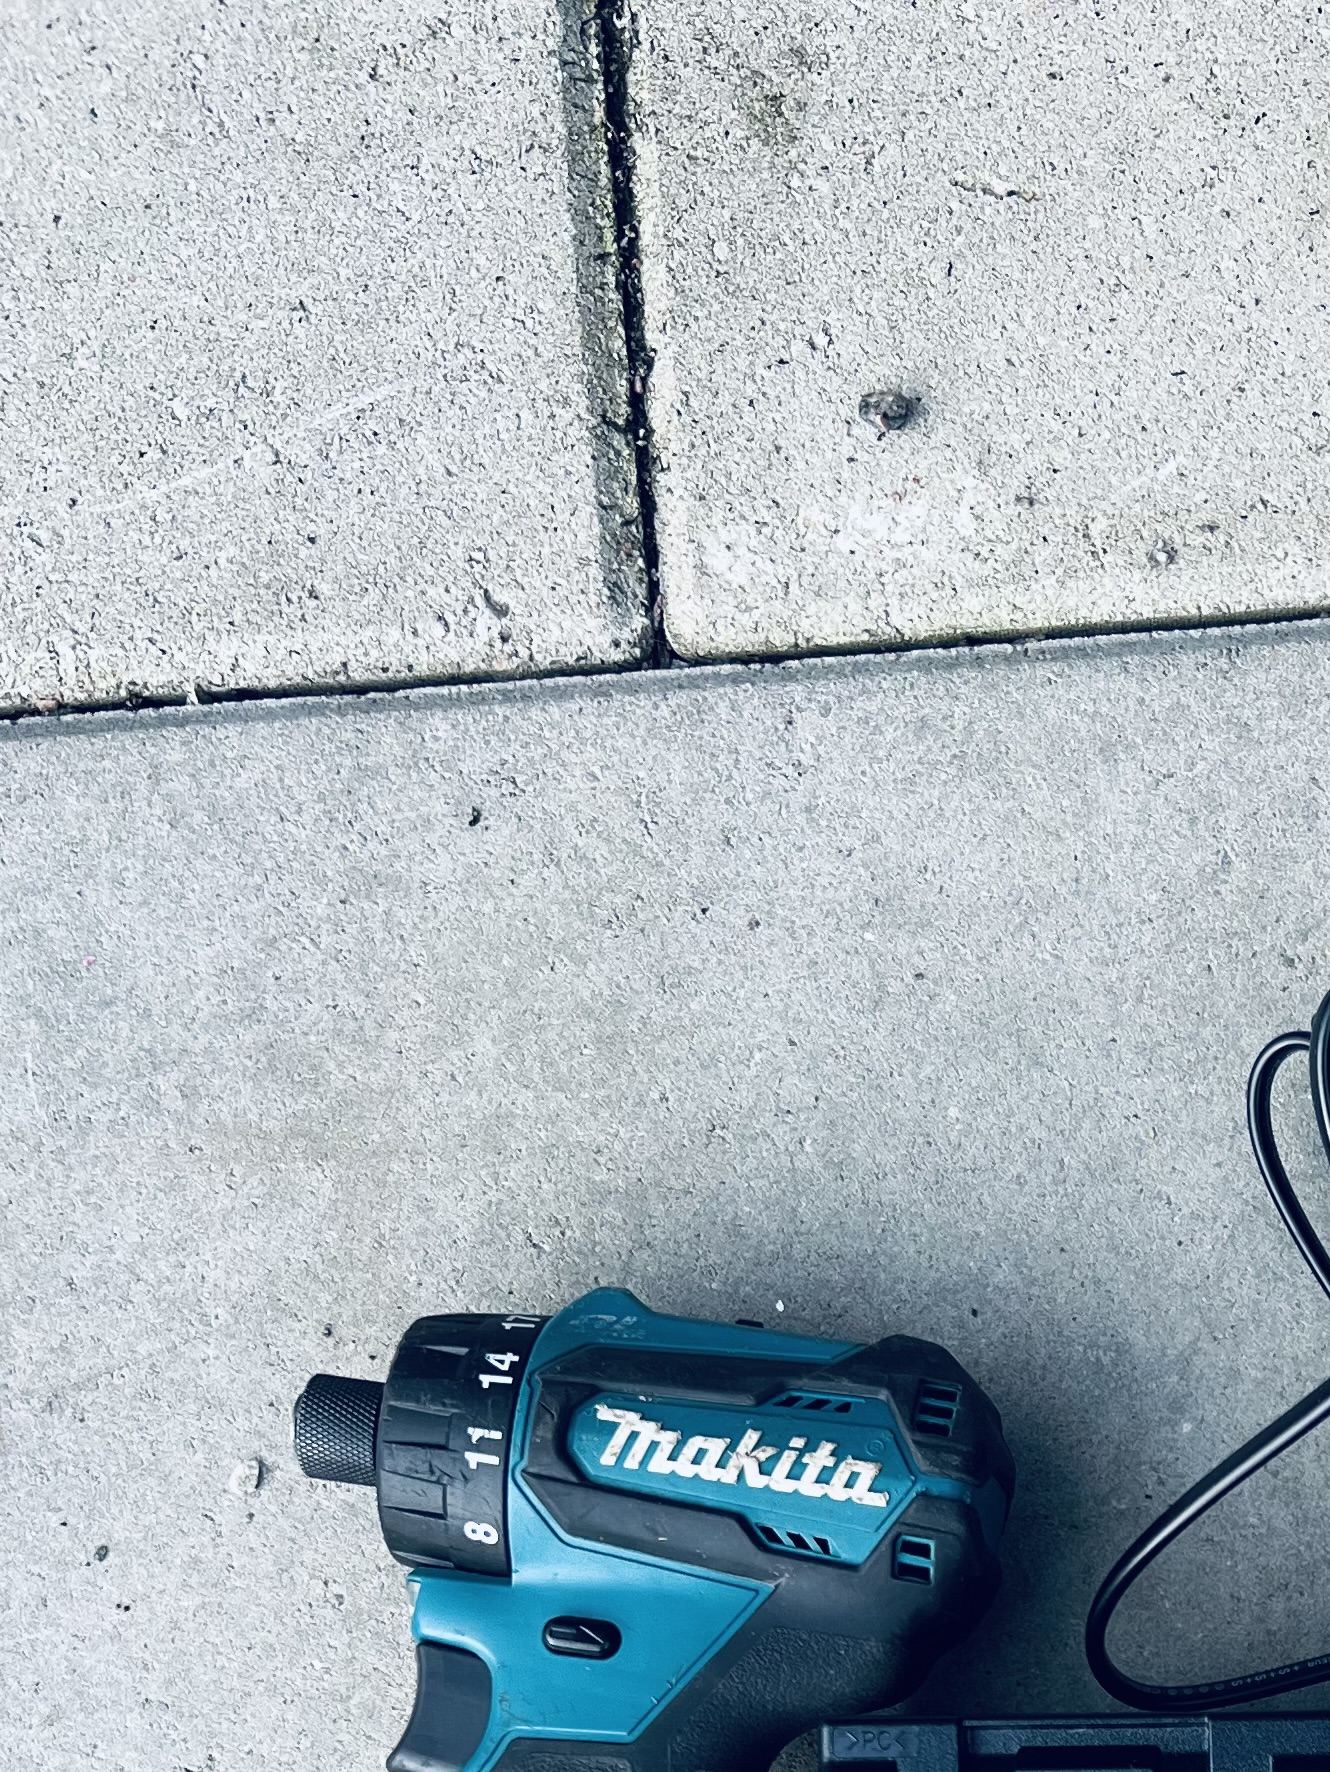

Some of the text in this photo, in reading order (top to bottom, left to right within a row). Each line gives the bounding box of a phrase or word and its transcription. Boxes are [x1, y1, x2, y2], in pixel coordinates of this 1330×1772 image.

[478, 1351, 520, 1389] 14
[464, 1426, 503, 1471] 11
[464, 1520, 498, 1544] 8
